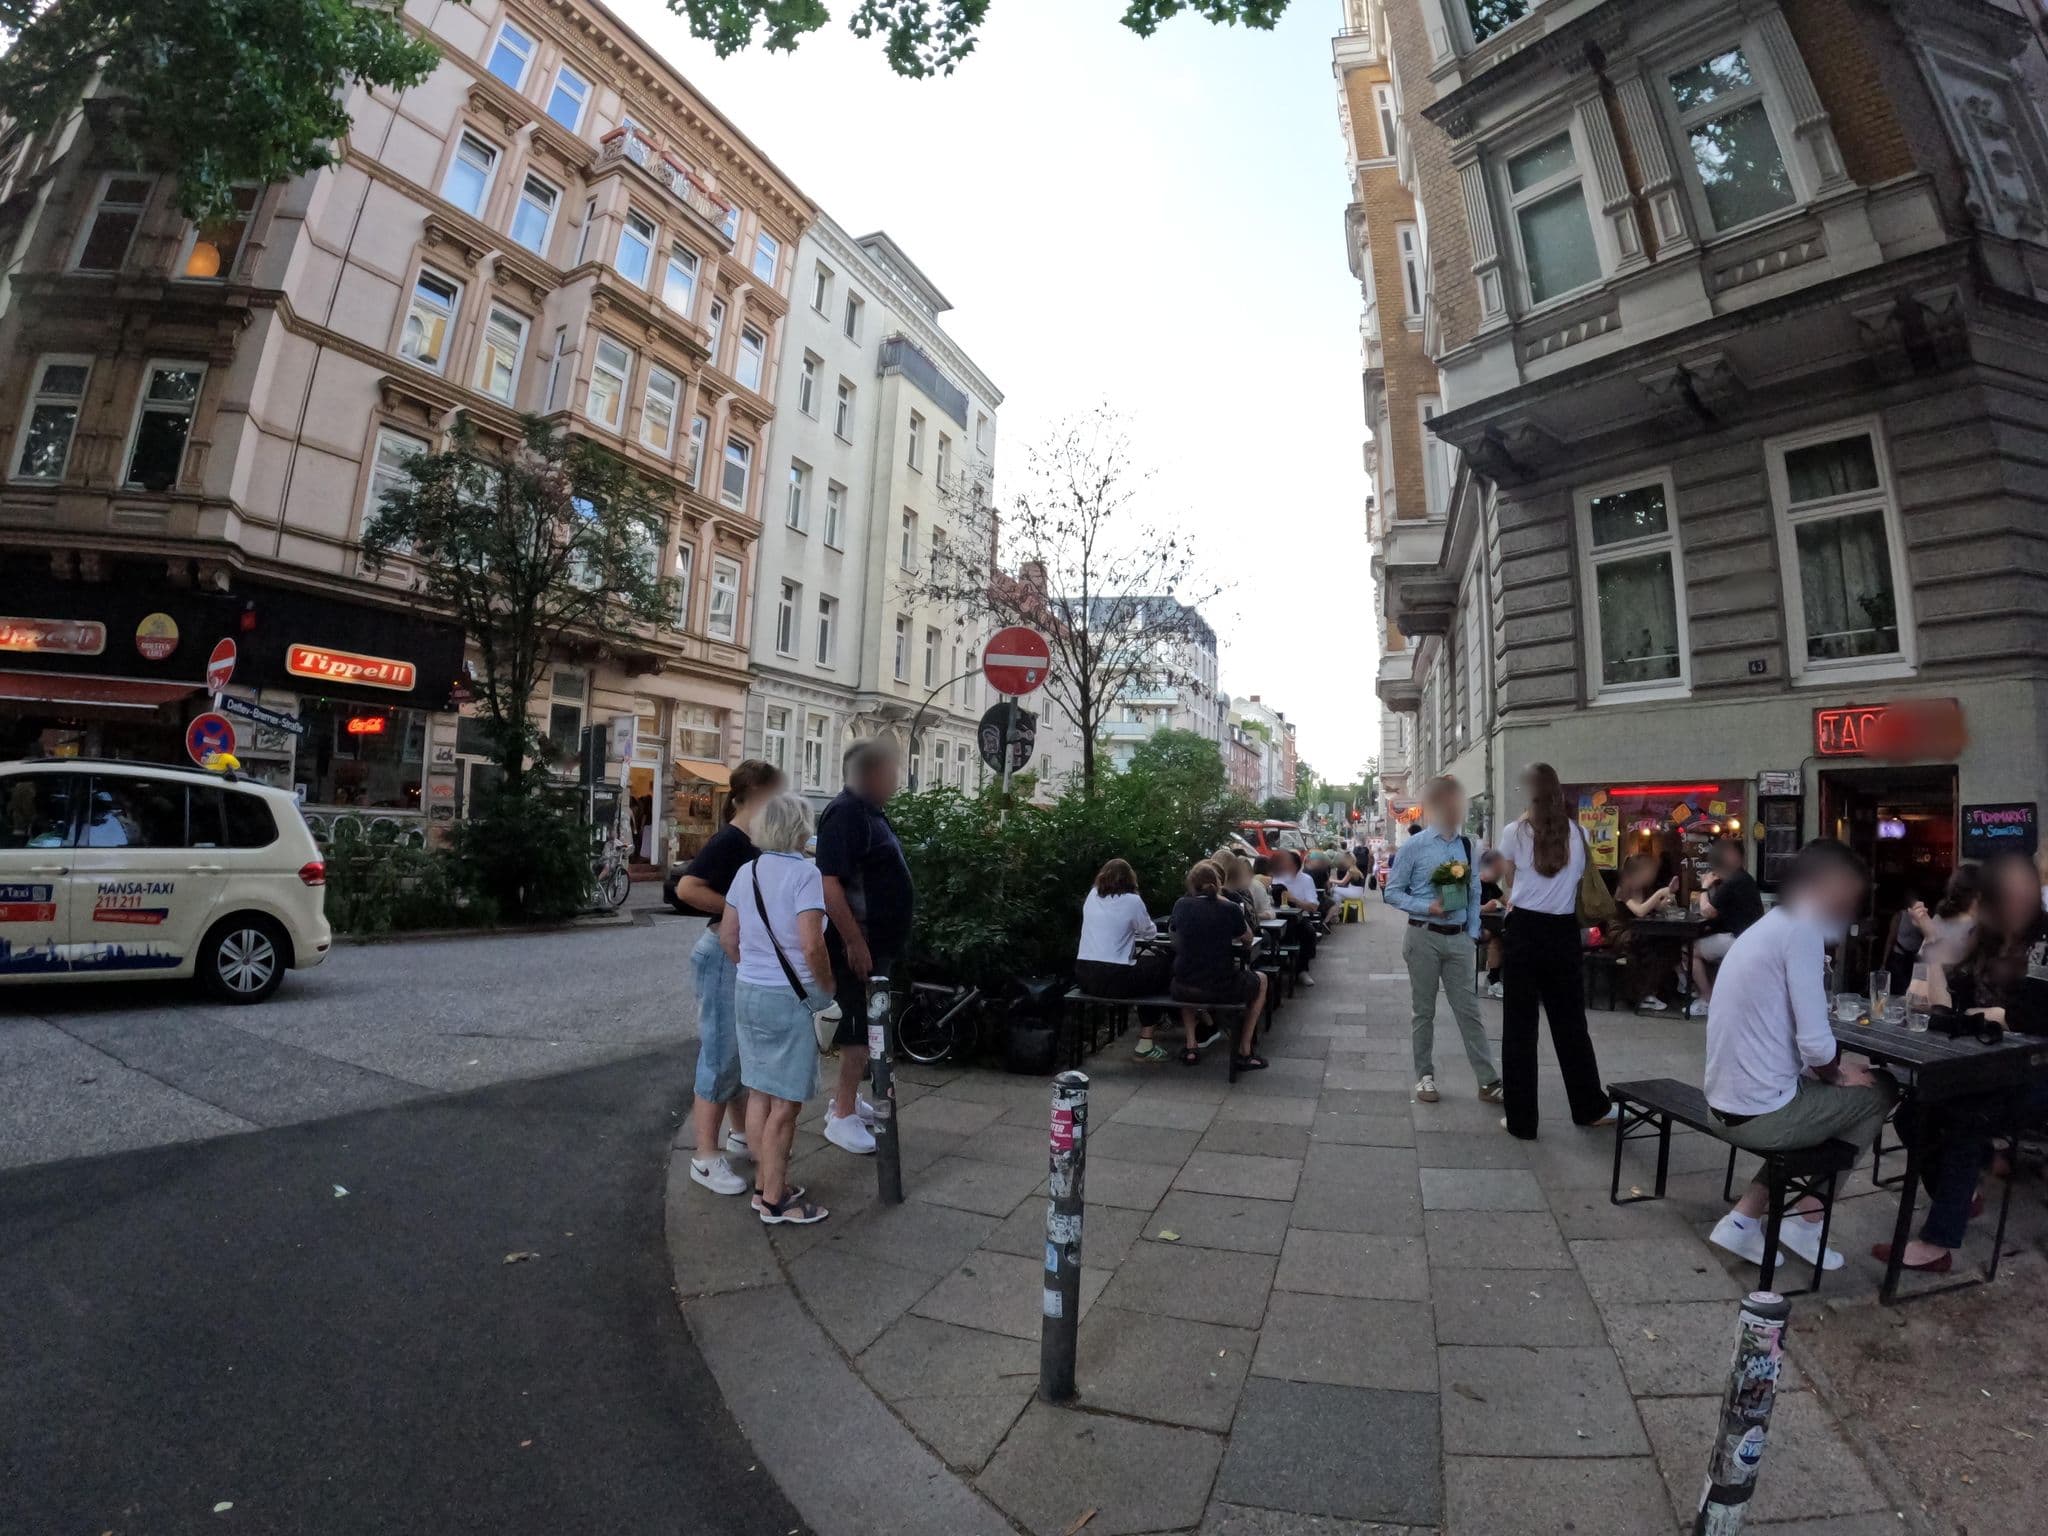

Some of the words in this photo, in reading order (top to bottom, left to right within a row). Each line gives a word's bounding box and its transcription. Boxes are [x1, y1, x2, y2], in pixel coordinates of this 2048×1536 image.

[299, 651, 389, 679] Tippel
[1751, 660, 1764, 673] 43
[97, 882, 174, 895] HANSA-TAXI
